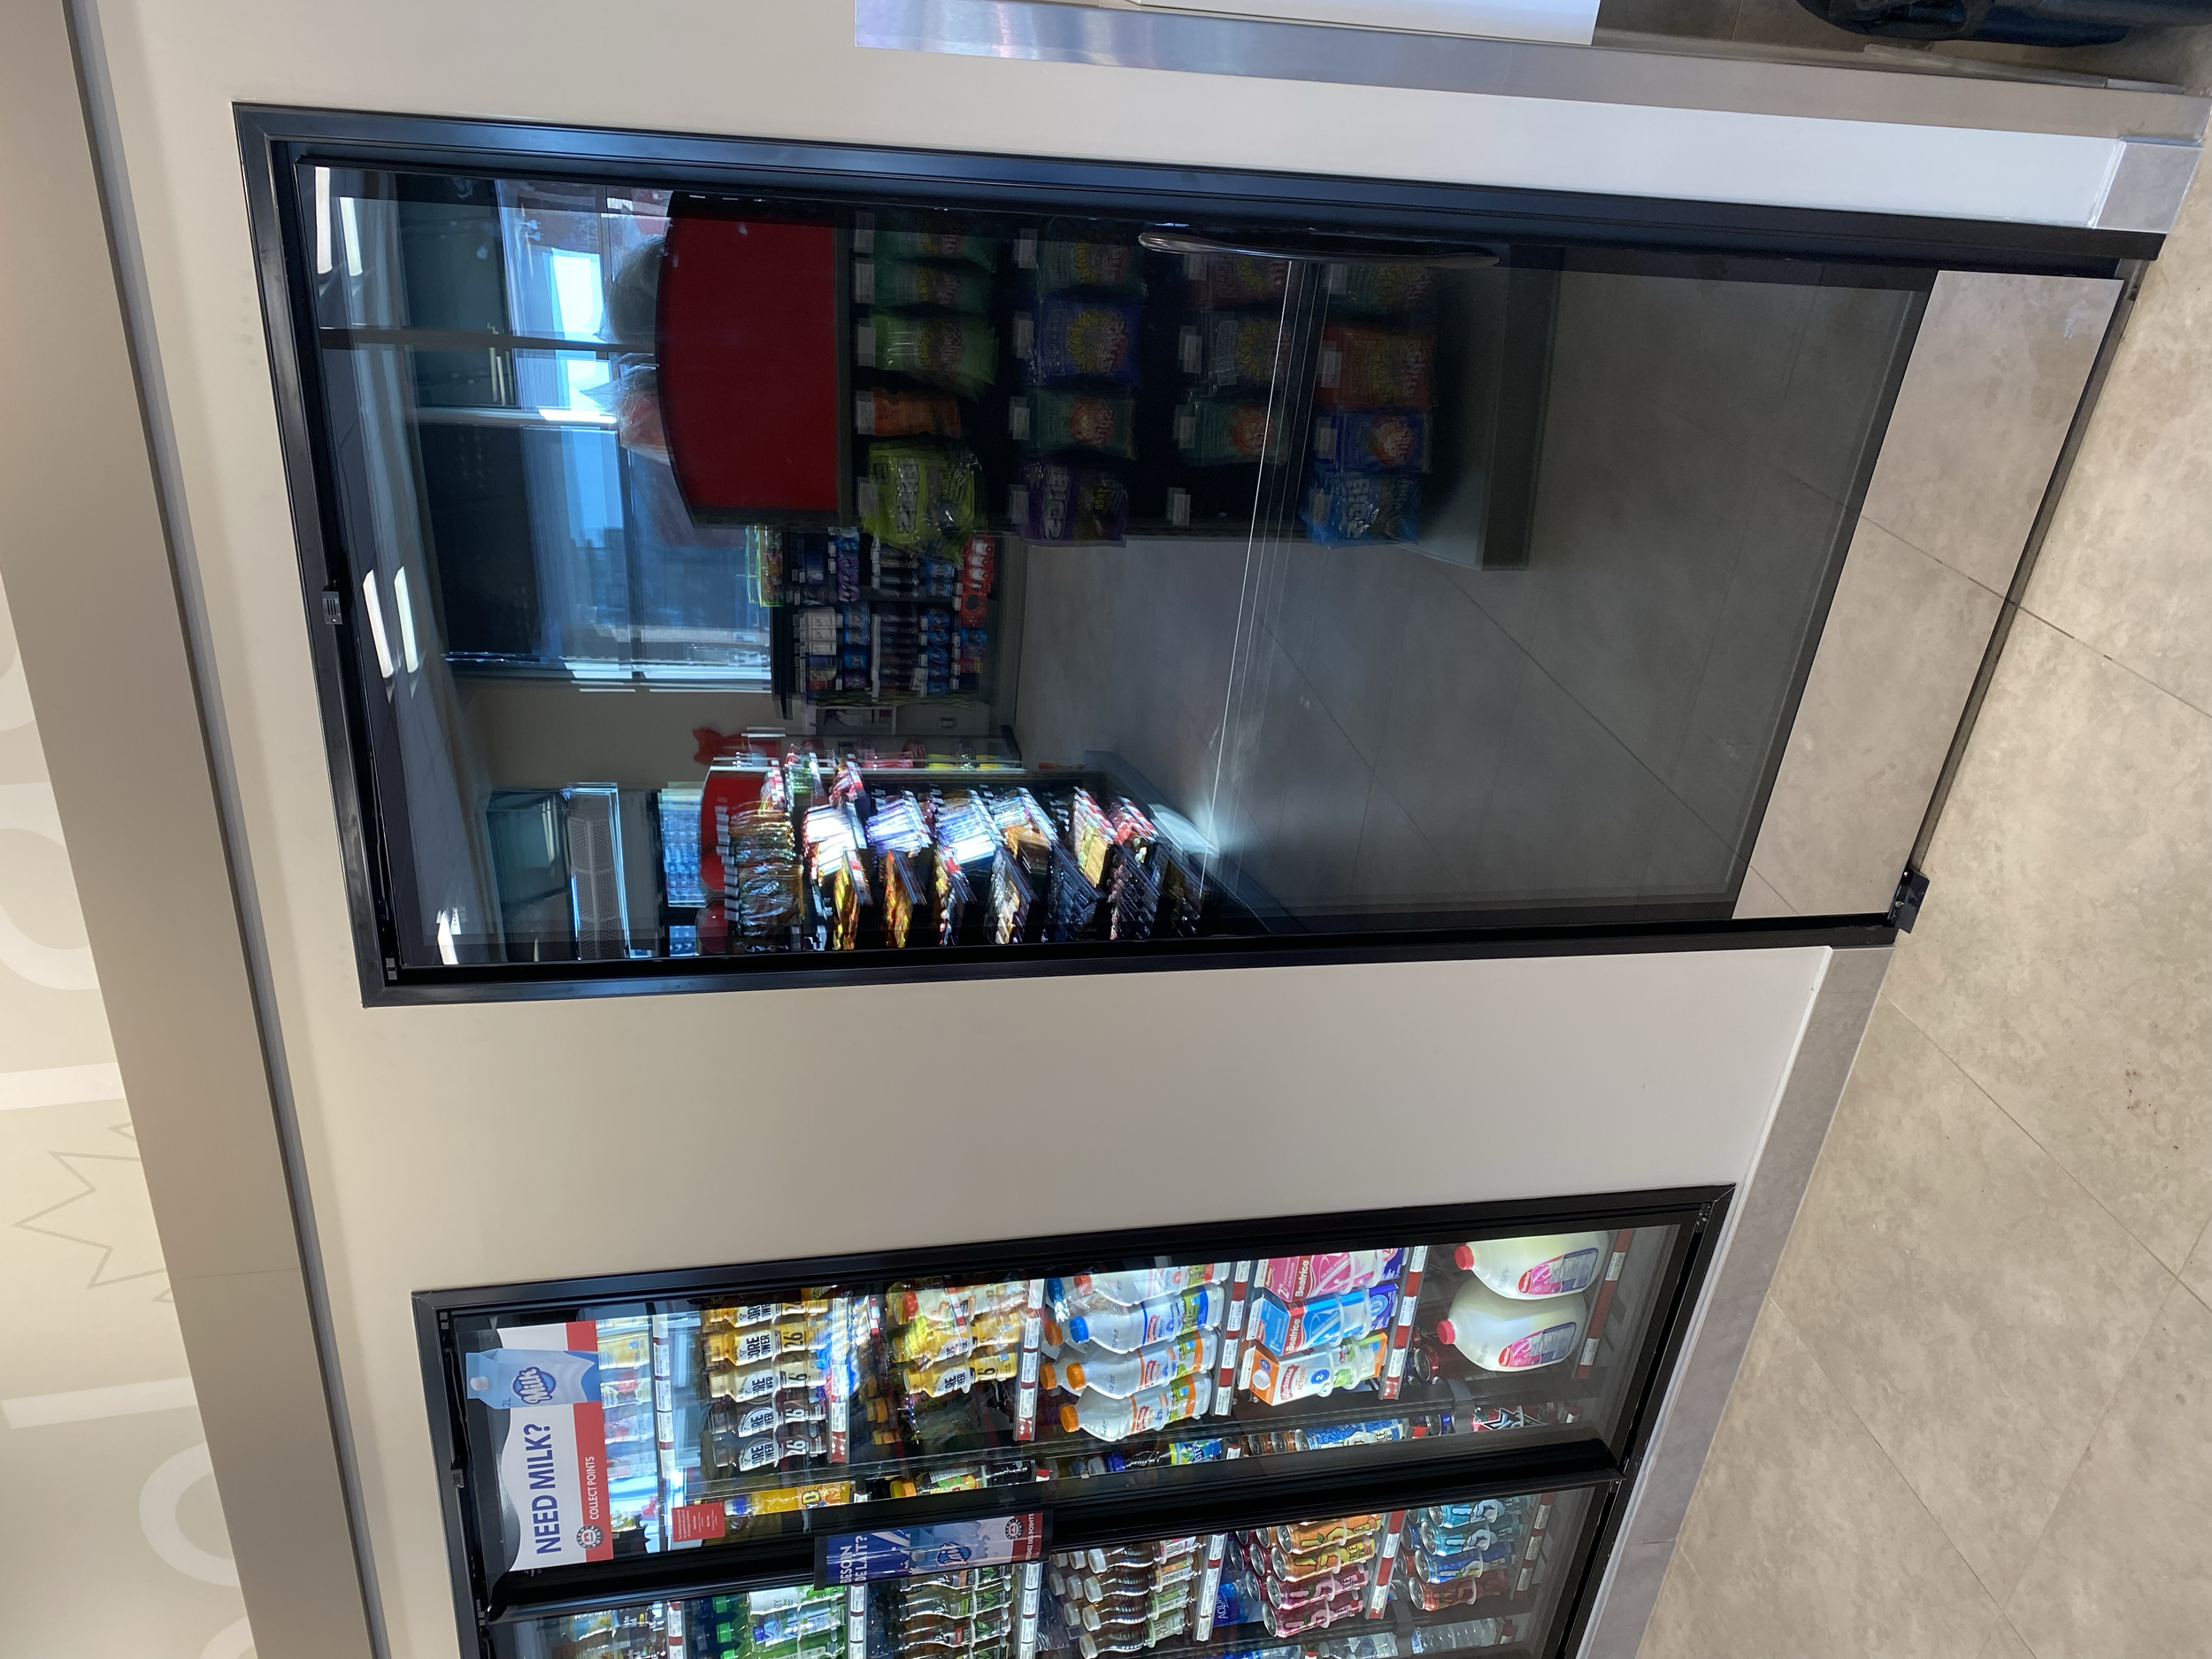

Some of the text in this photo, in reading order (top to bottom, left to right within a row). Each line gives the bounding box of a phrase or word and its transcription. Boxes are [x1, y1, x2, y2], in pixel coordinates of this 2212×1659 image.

[1295, 1260, 1310, 1297] Beatrice
[761, 1334, 772, 1356] OWER
[1286, 1318, 1301, 1351] Beatrice
[518, 1367, 552, 1404] Milk
[1281, 1368, 1294, 1398] Lactantia
[502, 1397, 511, 1408] 2L
[523, 1423, 562, 1555] NEED MILK?
[585, 1456, 599, 1520] COLLECT POINTS
[840, 1545, 853, 1584] BESOIN
[855, 1536, 867, 1570] LAIT?
[855, 1571, 867, 1582] DE
